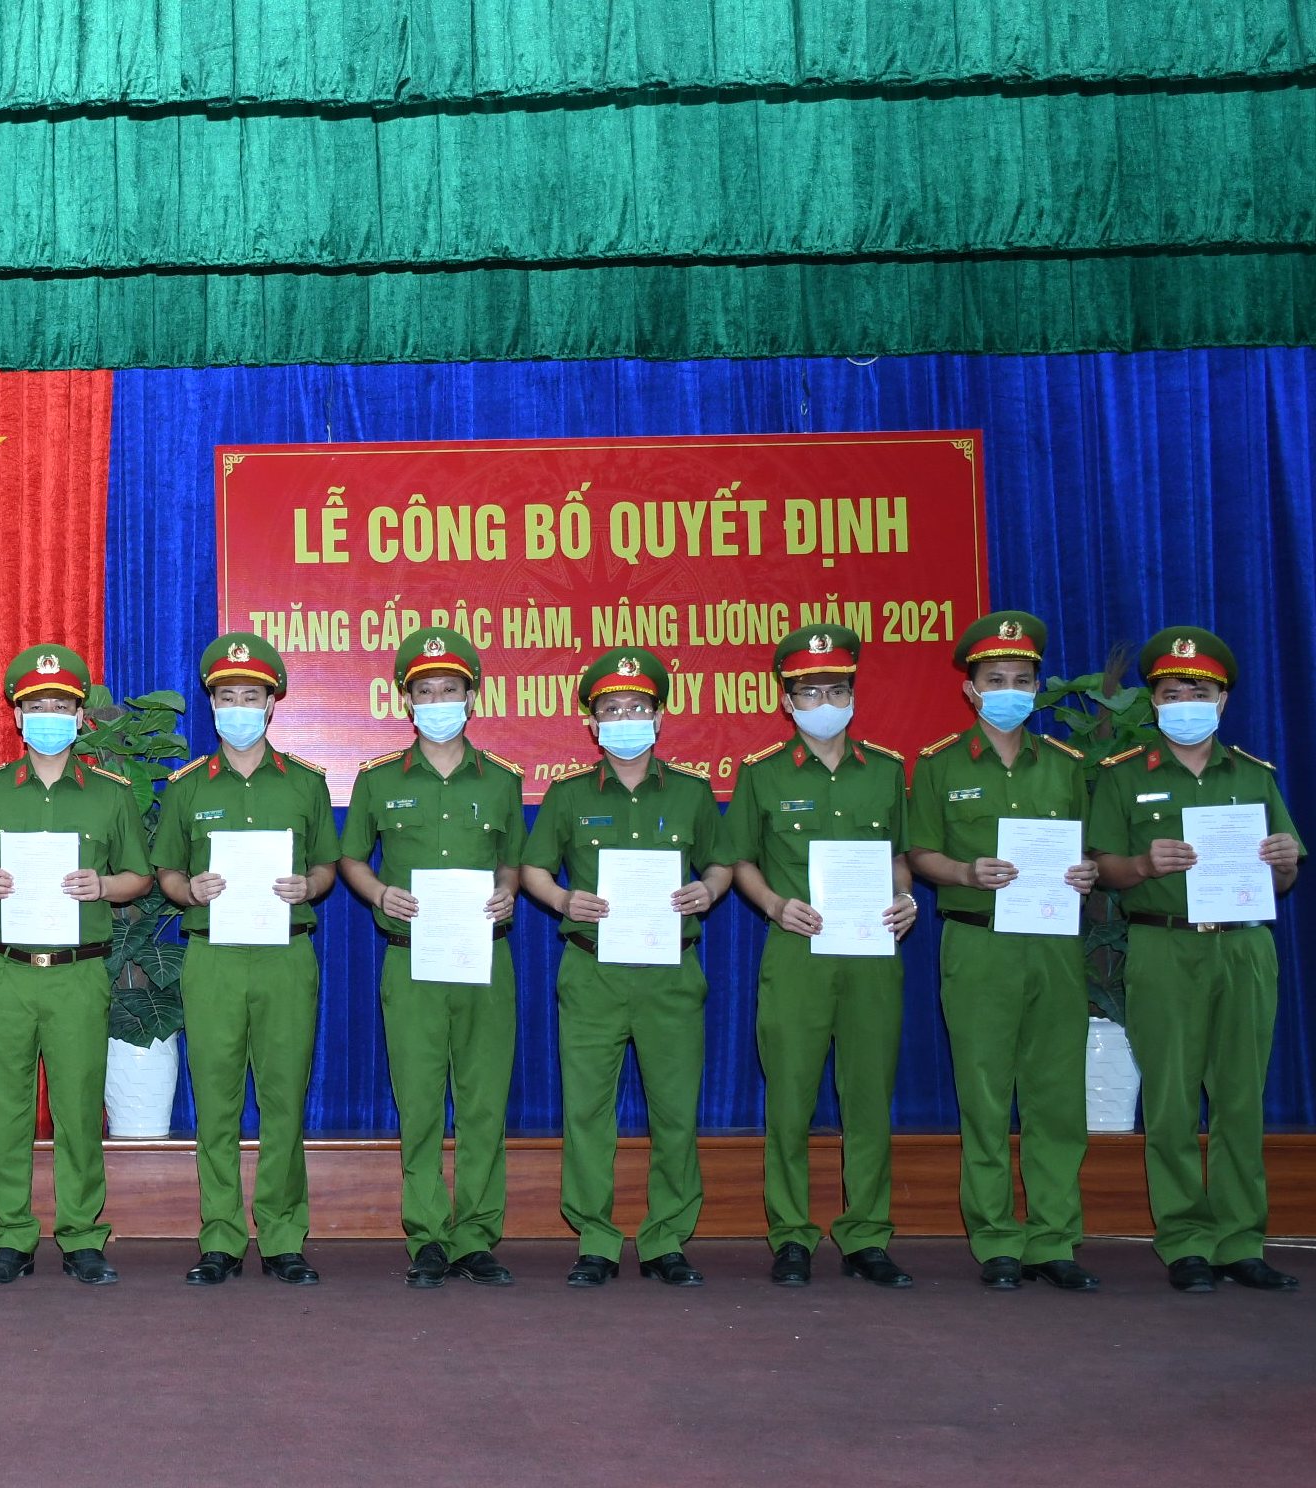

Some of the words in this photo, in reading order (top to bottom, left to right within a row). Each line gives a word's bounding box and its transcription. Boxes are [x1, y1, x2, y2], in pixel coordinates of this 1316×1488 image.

[294, 486, 349, 563] LỄ
[368, 493, 506, 563] CÔNG
[524, 481, 591, 560] BỐ
[609, 481, 767, 565] QUYẾT
[783, 497, 909, 568] ĐỊNH
[249, 602, 350, 652] THĂNG
[503, 598, 581, 653] HÀM,
[592, 597, 678, 647] NÂNG
[688, 600, 790, 646] LƯƠNG
[883, 600, 954, 642] 2021
[718, 756, 733, 778] 6
